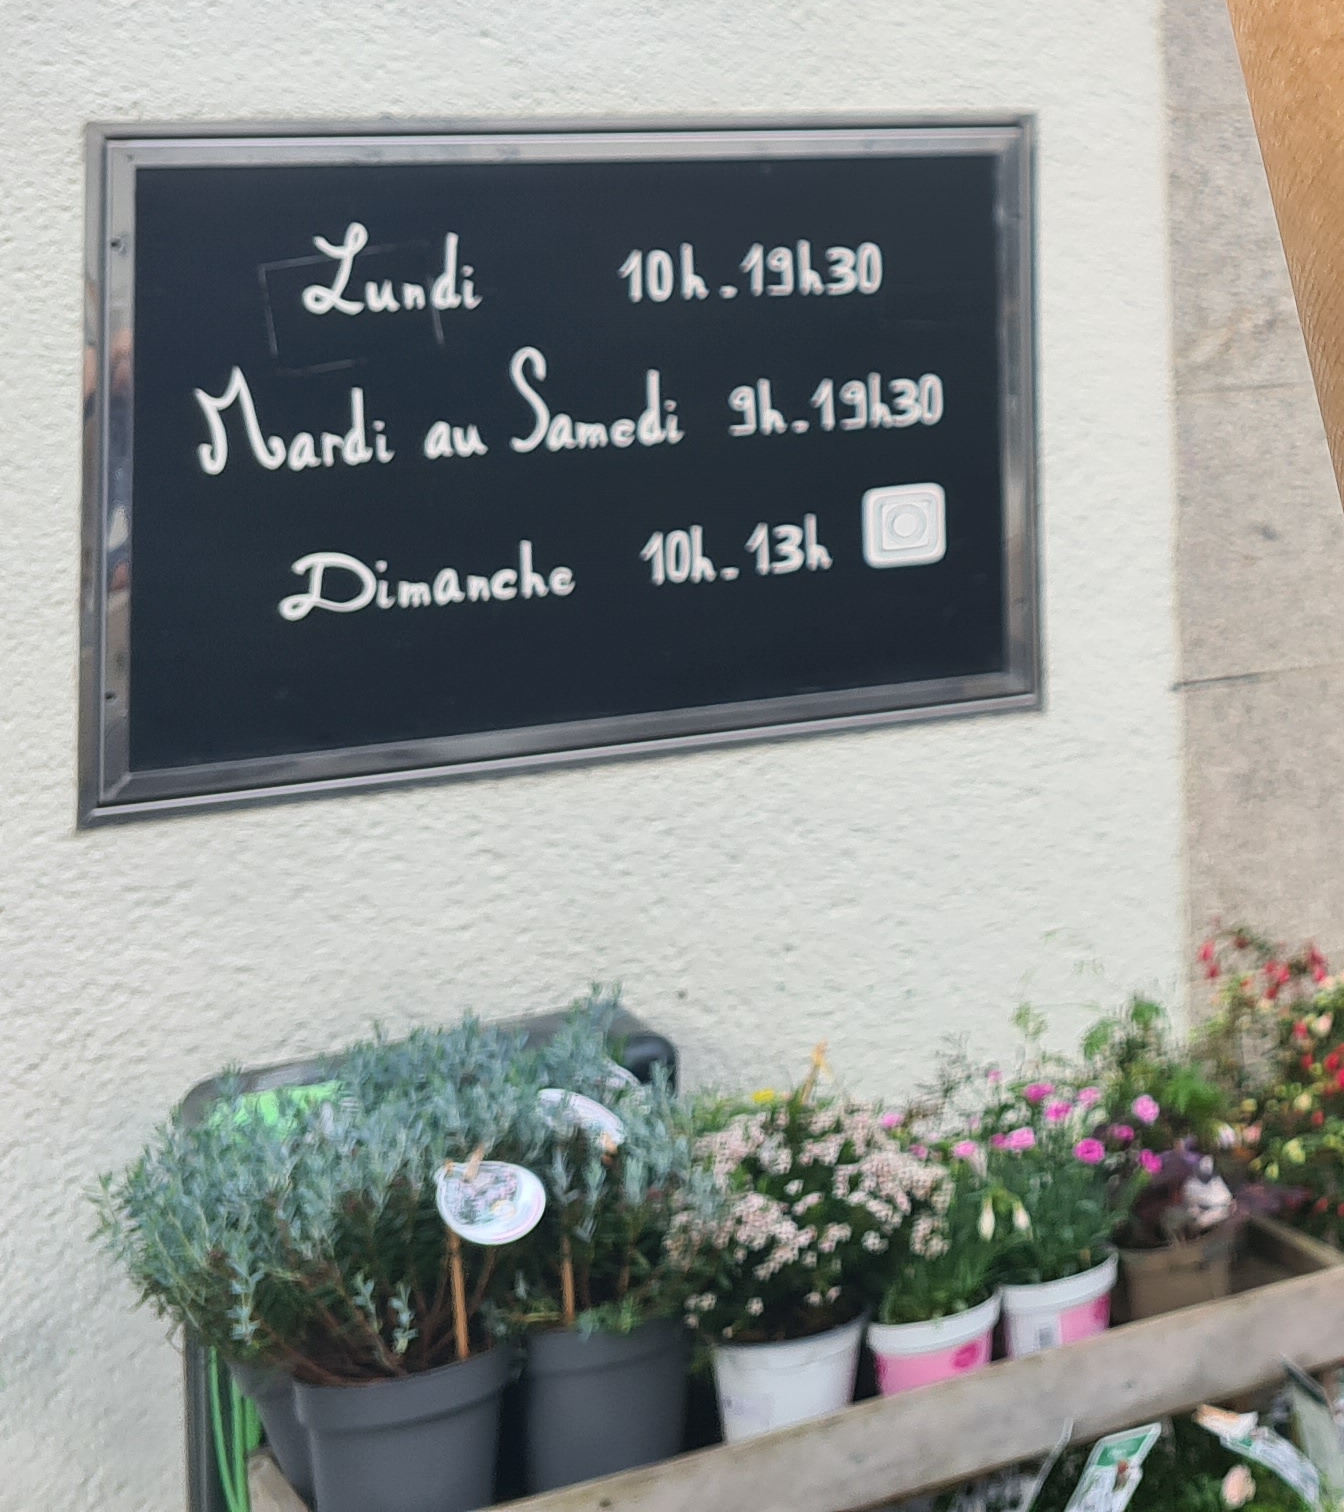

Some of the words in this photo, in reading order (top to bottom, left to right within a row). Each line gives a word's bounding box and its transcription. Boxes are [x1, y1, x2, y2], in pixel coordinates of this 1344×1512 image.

[301, 221, 483, 315] Lundi
[195, 365, 395, 475] Mardi
[424, 420, 489, 459] au
[510, 346, 684, 453] Samedi
[278, 540, 576, 621] Dimanche
